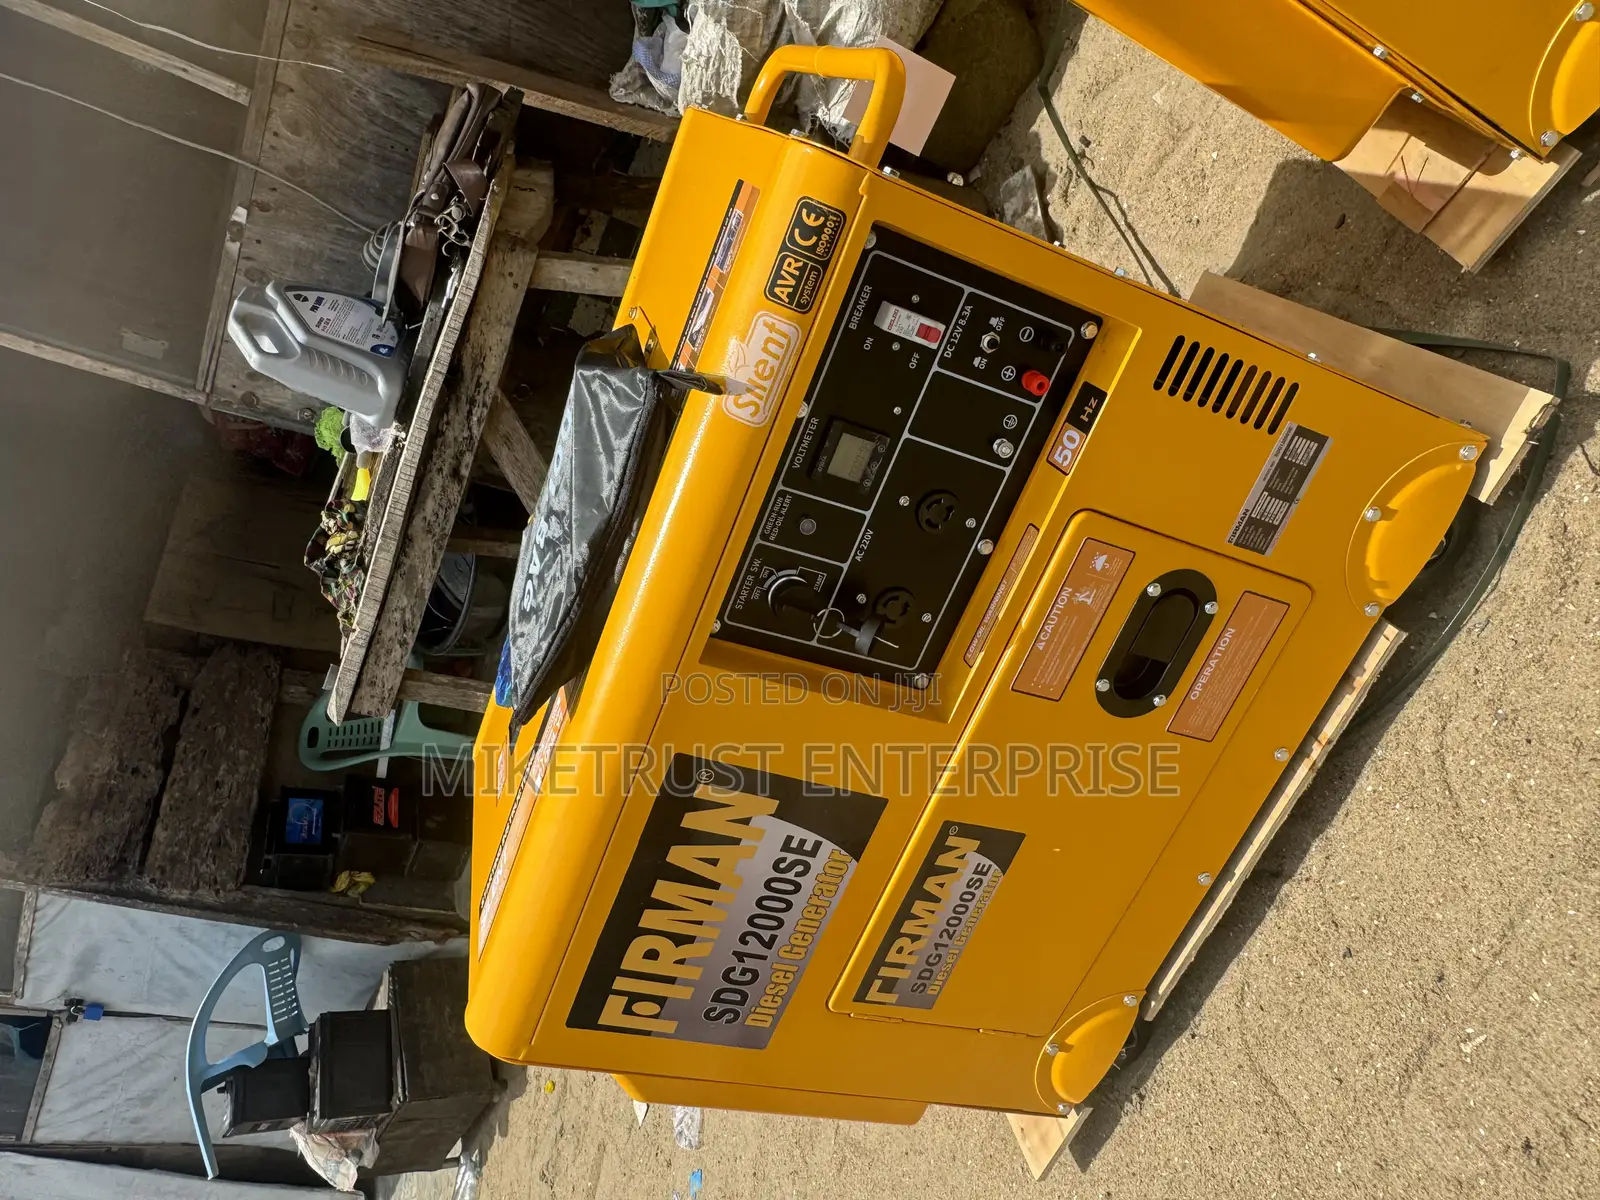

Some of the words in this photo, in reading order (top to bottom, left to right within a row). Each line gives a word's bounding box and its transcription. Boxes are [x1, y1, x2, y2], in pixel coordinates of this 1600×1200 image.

[774, 257, 804, 303] AVR
[800, 270, 818, 305] system
[848, 284, 873, 330] BREAKER
[995, 316, 1006, 332] OFF
[863, 337, 875, 351] ON
[944, 344, 956, 358] DC
[953, 325, 963, 344] 12V
[958, 304, 974, 326] 8.3A
[733, 318, 791, 418] Silent
[908, 352, 921, 369] OFF
[978, 358, 988, 370] ON
[1080, 397, 1098, 422] Hz
[792, 416, 820, 469] VOLTMETER
[1053, 429, 1080, 467] 50
[781, 494, 793, 516] ALERT
[1227, 508, 1250, 544] FIRMAN
[855, 549, 866, 562] AC
[860, 529, 874, 550] 220V
[735, 573, 755, 610] STARTER
[750, 557, 763, 573] SW.
[1040, 586, 1073, 641] CAUTION
[966, 639, 978, 659] LOW
[976, 624, 986, 639] OIL
[1190, 627, 1236, 701] OPERATION
[597, 783, 780, 1034] FIRMAN
[702, 834, 824, 1025] SDG12000SE
[864, 835, 981, 1004] FIRMAN
[910, 862, 993, 994] SDG12000SE
[744, 961, 800, 1028] Diesel
[777, 848, 854, 961] Generator
[927, 949, 960, 995] Diesel
[953, 869, 1003, 946] Generator
